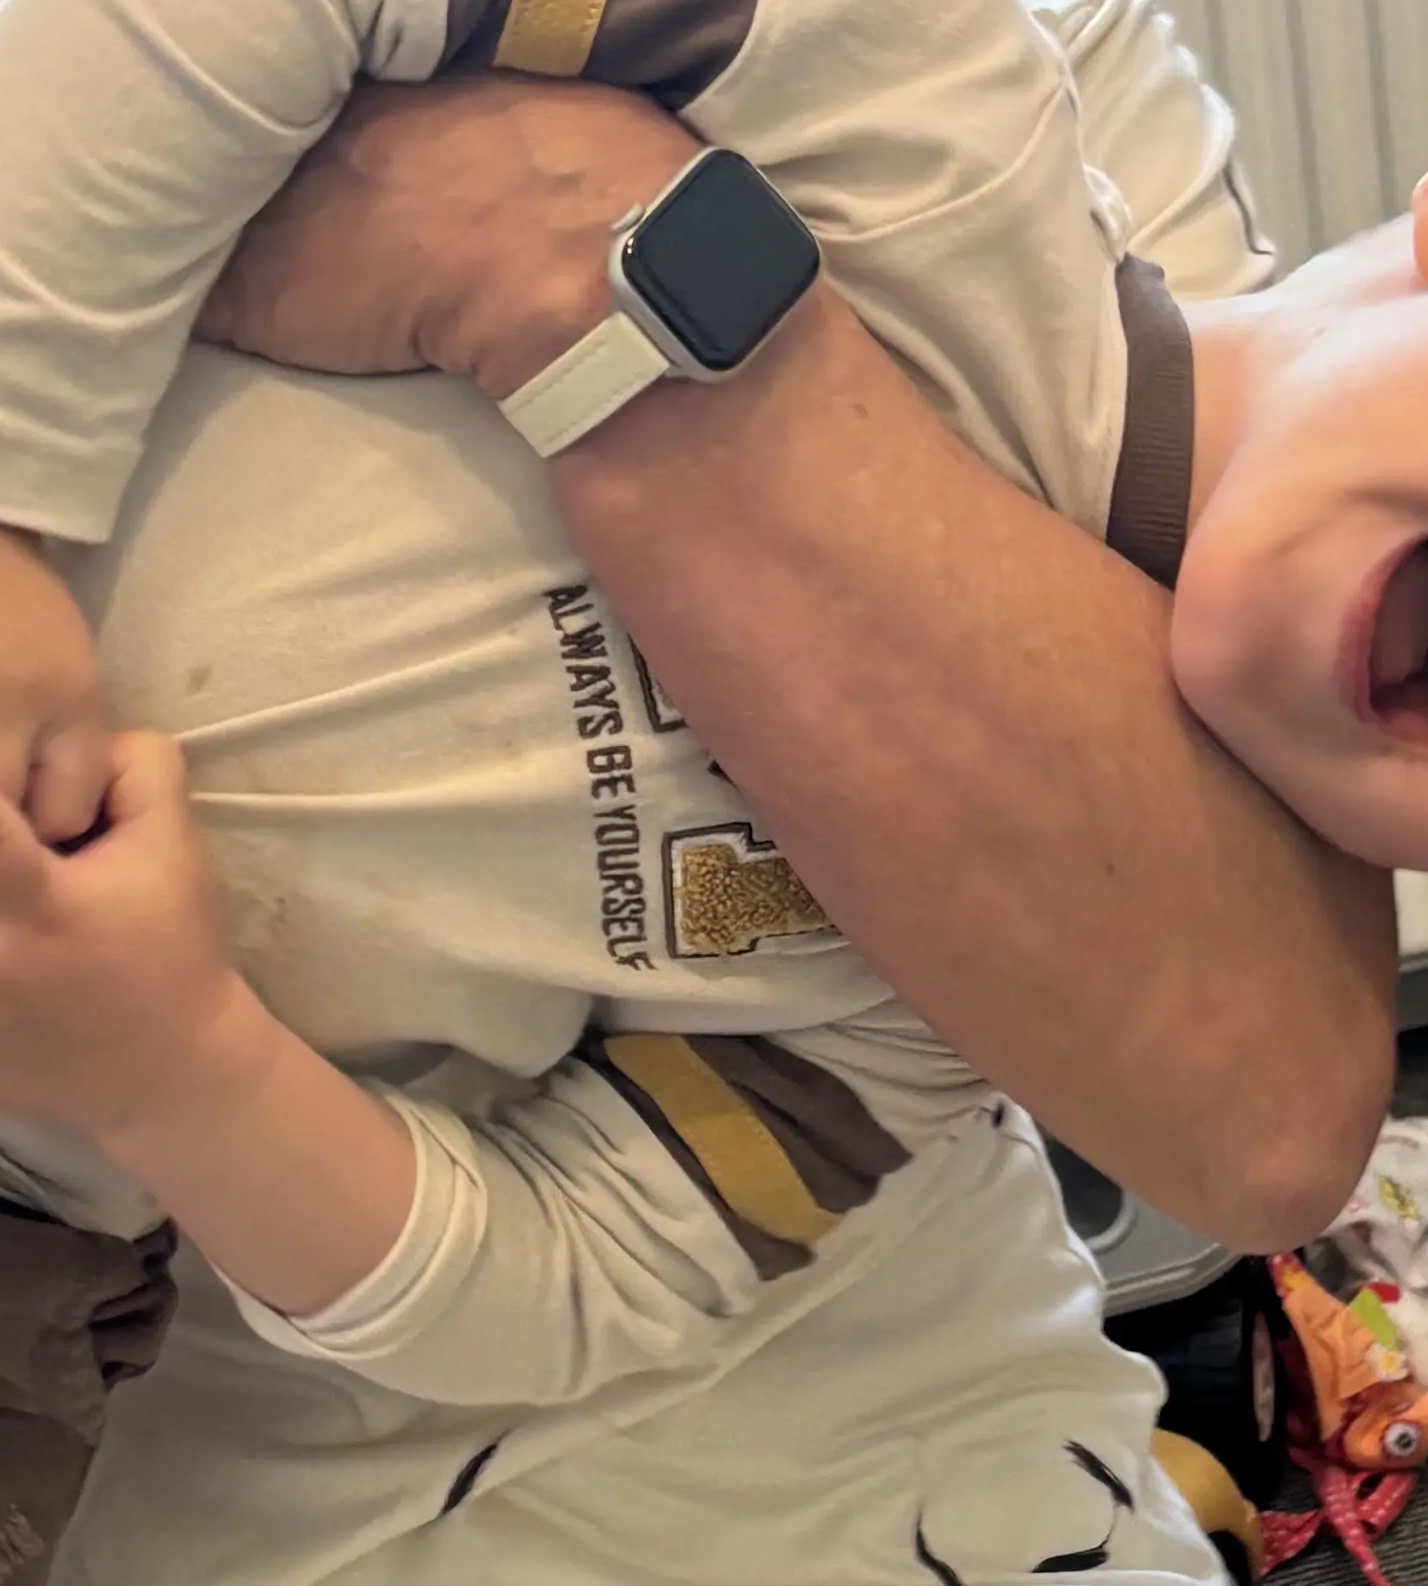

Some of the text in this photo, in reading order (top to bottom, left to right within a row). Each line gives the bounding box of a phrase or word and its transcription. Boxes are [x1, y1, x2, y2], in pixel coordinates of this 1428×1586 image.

[542, 584, 624, 740] ALWAYS
[586, 744, 637, 800] BE
[592, 804, 659, 972] YOURSELF
